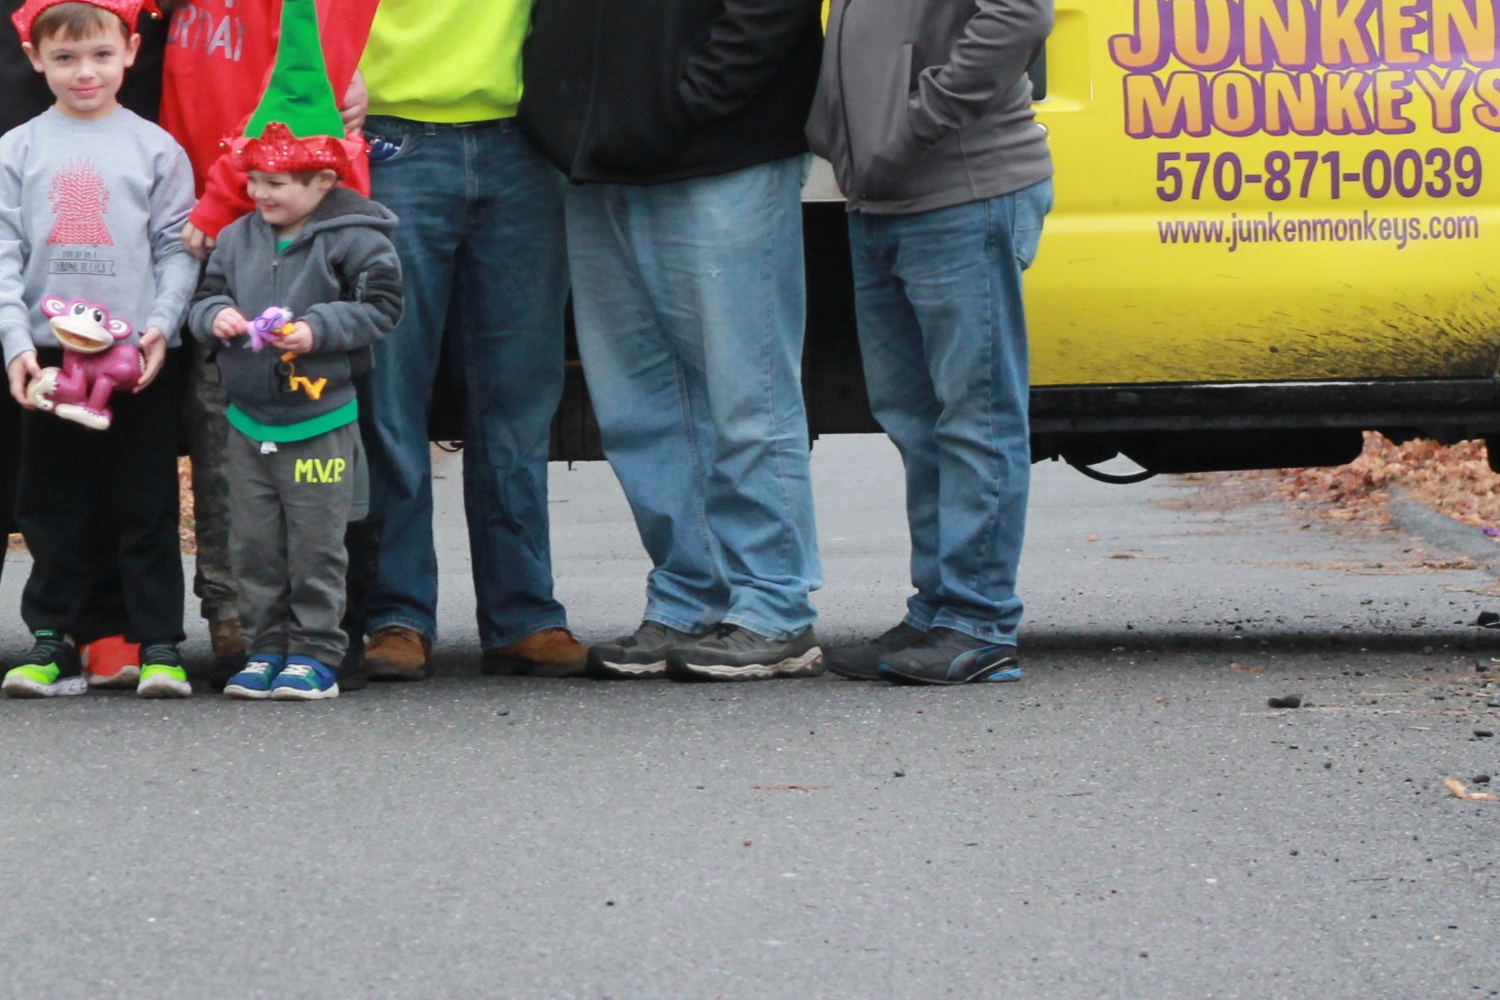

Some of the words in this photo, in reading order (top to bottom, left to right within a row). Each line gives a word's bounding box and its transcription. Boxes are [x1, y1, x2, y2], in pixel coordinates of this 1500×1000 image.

[1122, 68, 1500, 139] MONKEYS
[1155, 146, 1483, 202] 570-871-0039
[1157, 210, 1480, 253] www.junkenmonkeys.com
